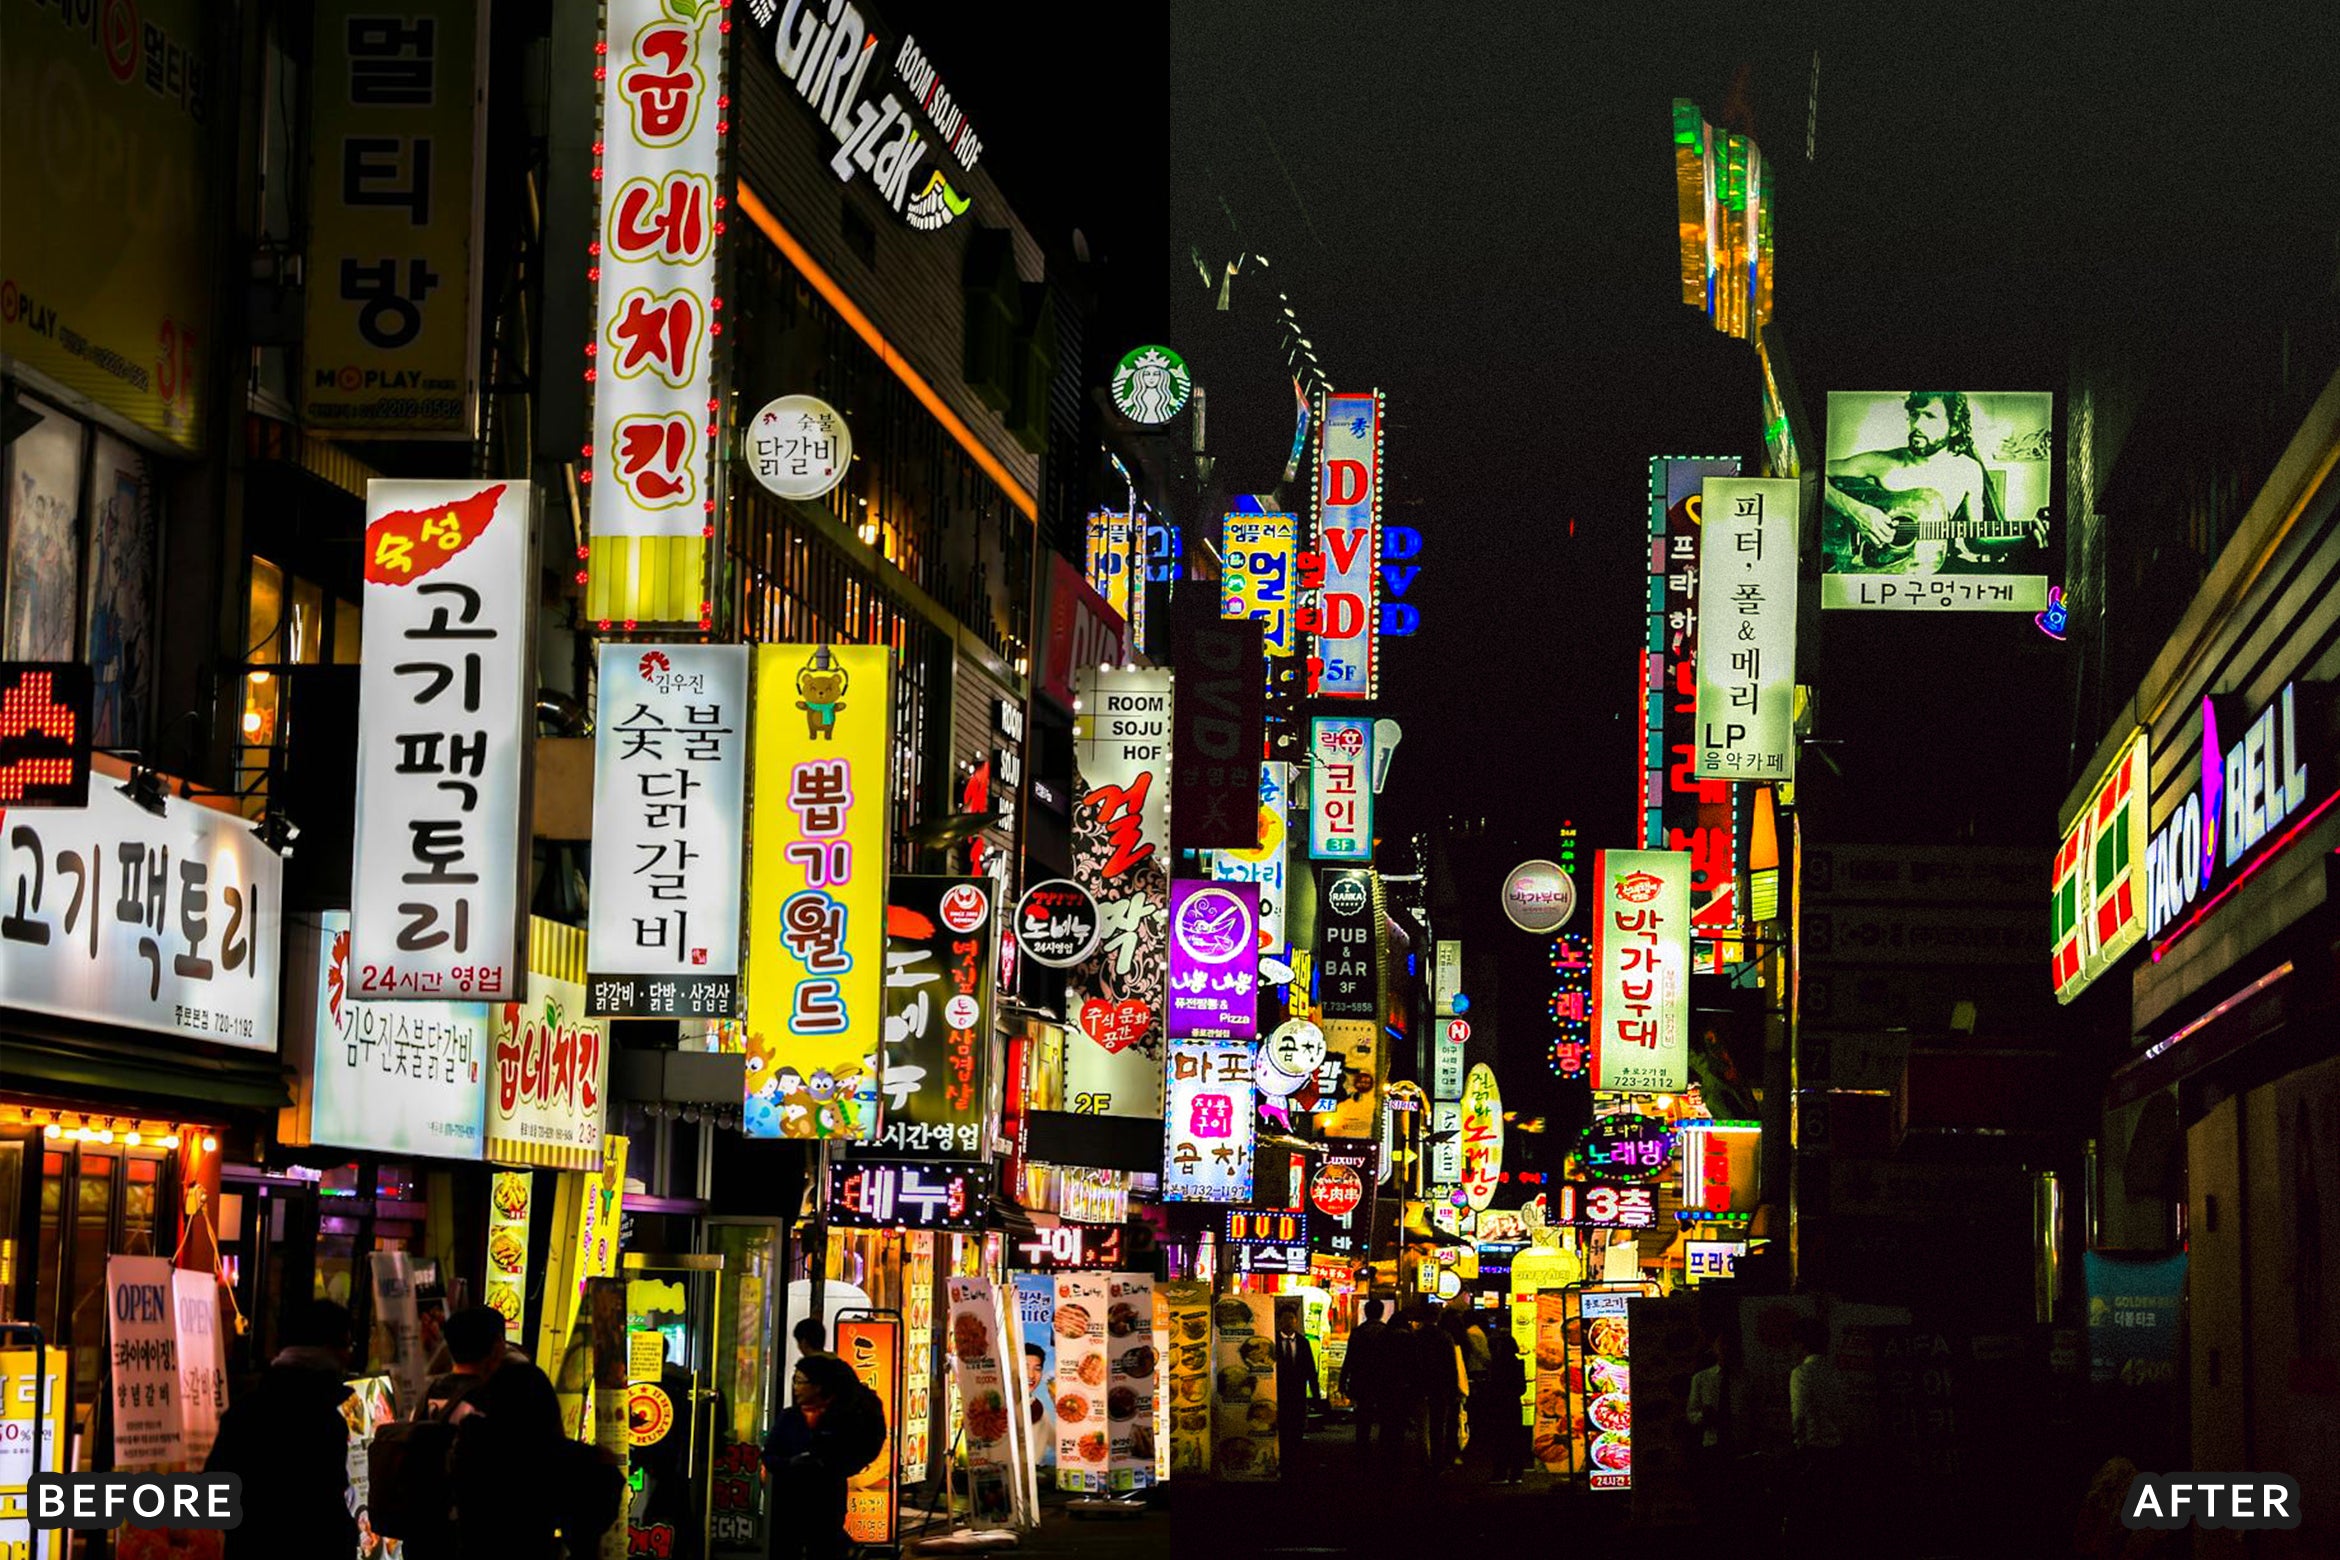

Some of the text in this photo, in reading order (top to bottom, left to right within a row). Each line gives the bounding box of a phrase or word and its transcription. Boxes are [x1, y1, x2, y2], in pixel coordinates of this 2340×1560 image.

[896, 34, 983, 173] ROOM SOJU HOF
[341, 17, 440, 349] 멀티방
[617, 29, 701, 499] 굽네치킨
[797, 413, 836, 433] 숯불
[756, 436, 839, 476] 닭갈비
[374, 511, 464, 574] 숙성
[1230, 523, 1294, 543] 엠플러스
[1322, 459, 1369, 640] DVD
[1379, 525, 1423, 637] DVD
[1668, 535, 1700, 638] 프라하
[655, 673, 704, 694] 김우진
[1325, 658, 1357, 683] 5F
[1107, 696, 1164, 712] ROOM
[612, 702, 734, 762] 숯불
[1111, 720, 1163, 737] SOJU
[1705, 723, 1747, 750] LP
[1122, 745, 1162, 760] HOF
[1704, 751, 1784, 772] 음악카페
[393, 581, 498, 954] 고기팩토리
[2226, 681, 2307, 867] BELL
[1324, 763, 1358, 833] 코인
[1330, 838, 1351, 853] 3F
[631, 767, 702, 964] 닭갈비
[2145, 792, 2201, 941] TACO
[781, 762, 852, 1034] 뽑기월드
[2, 825, 258, 1002] 고기팩토리
[1326, 928, 1368, 944] PUB
[1341, 946, 1351, 958] &
[361, 965, 502, 993] 24시간 영업
[1324, 960, 1368, 977] BAR
[1614, 908, 1665, 1050] 박가부대
[594, 981, 731, 1013] 닭갈비 닭발 삼겹살
[1339, 982, 1357, 994] 3F
[1219, 1012, 1251, 1025] Pizza
[1101, 1026, 1135, 1050] 공간
[497, 1000, 600, 1110] 굽네치킨
[1175, 1051, 1256, 1084] 마포
[1613, 1075, 1674, 1088] 723-2112
[1074, 1093, 1111, 1115] 2F
[1390, 1100, 1419, 1111] KIRIN
[854, 1121, 980, 1152] 시간영업
[1174, 1142, 1247, 1176] 곱창
[1322, 1153, 1366, 1168] Luxury
[1588, 1140, 1665, 1167] 노래방
[1192, 1184, 1246, 1197] 732-1197
[1314, 1186, 1361, 1203] 羊肉串
[1586, 1186, 1652, 1225] 3층
[1230, 1214, 1297, 1241] DVD
[1018, 1227, 1083, 1265] 구이
[116, 1283, 166, 1322] OPEN
